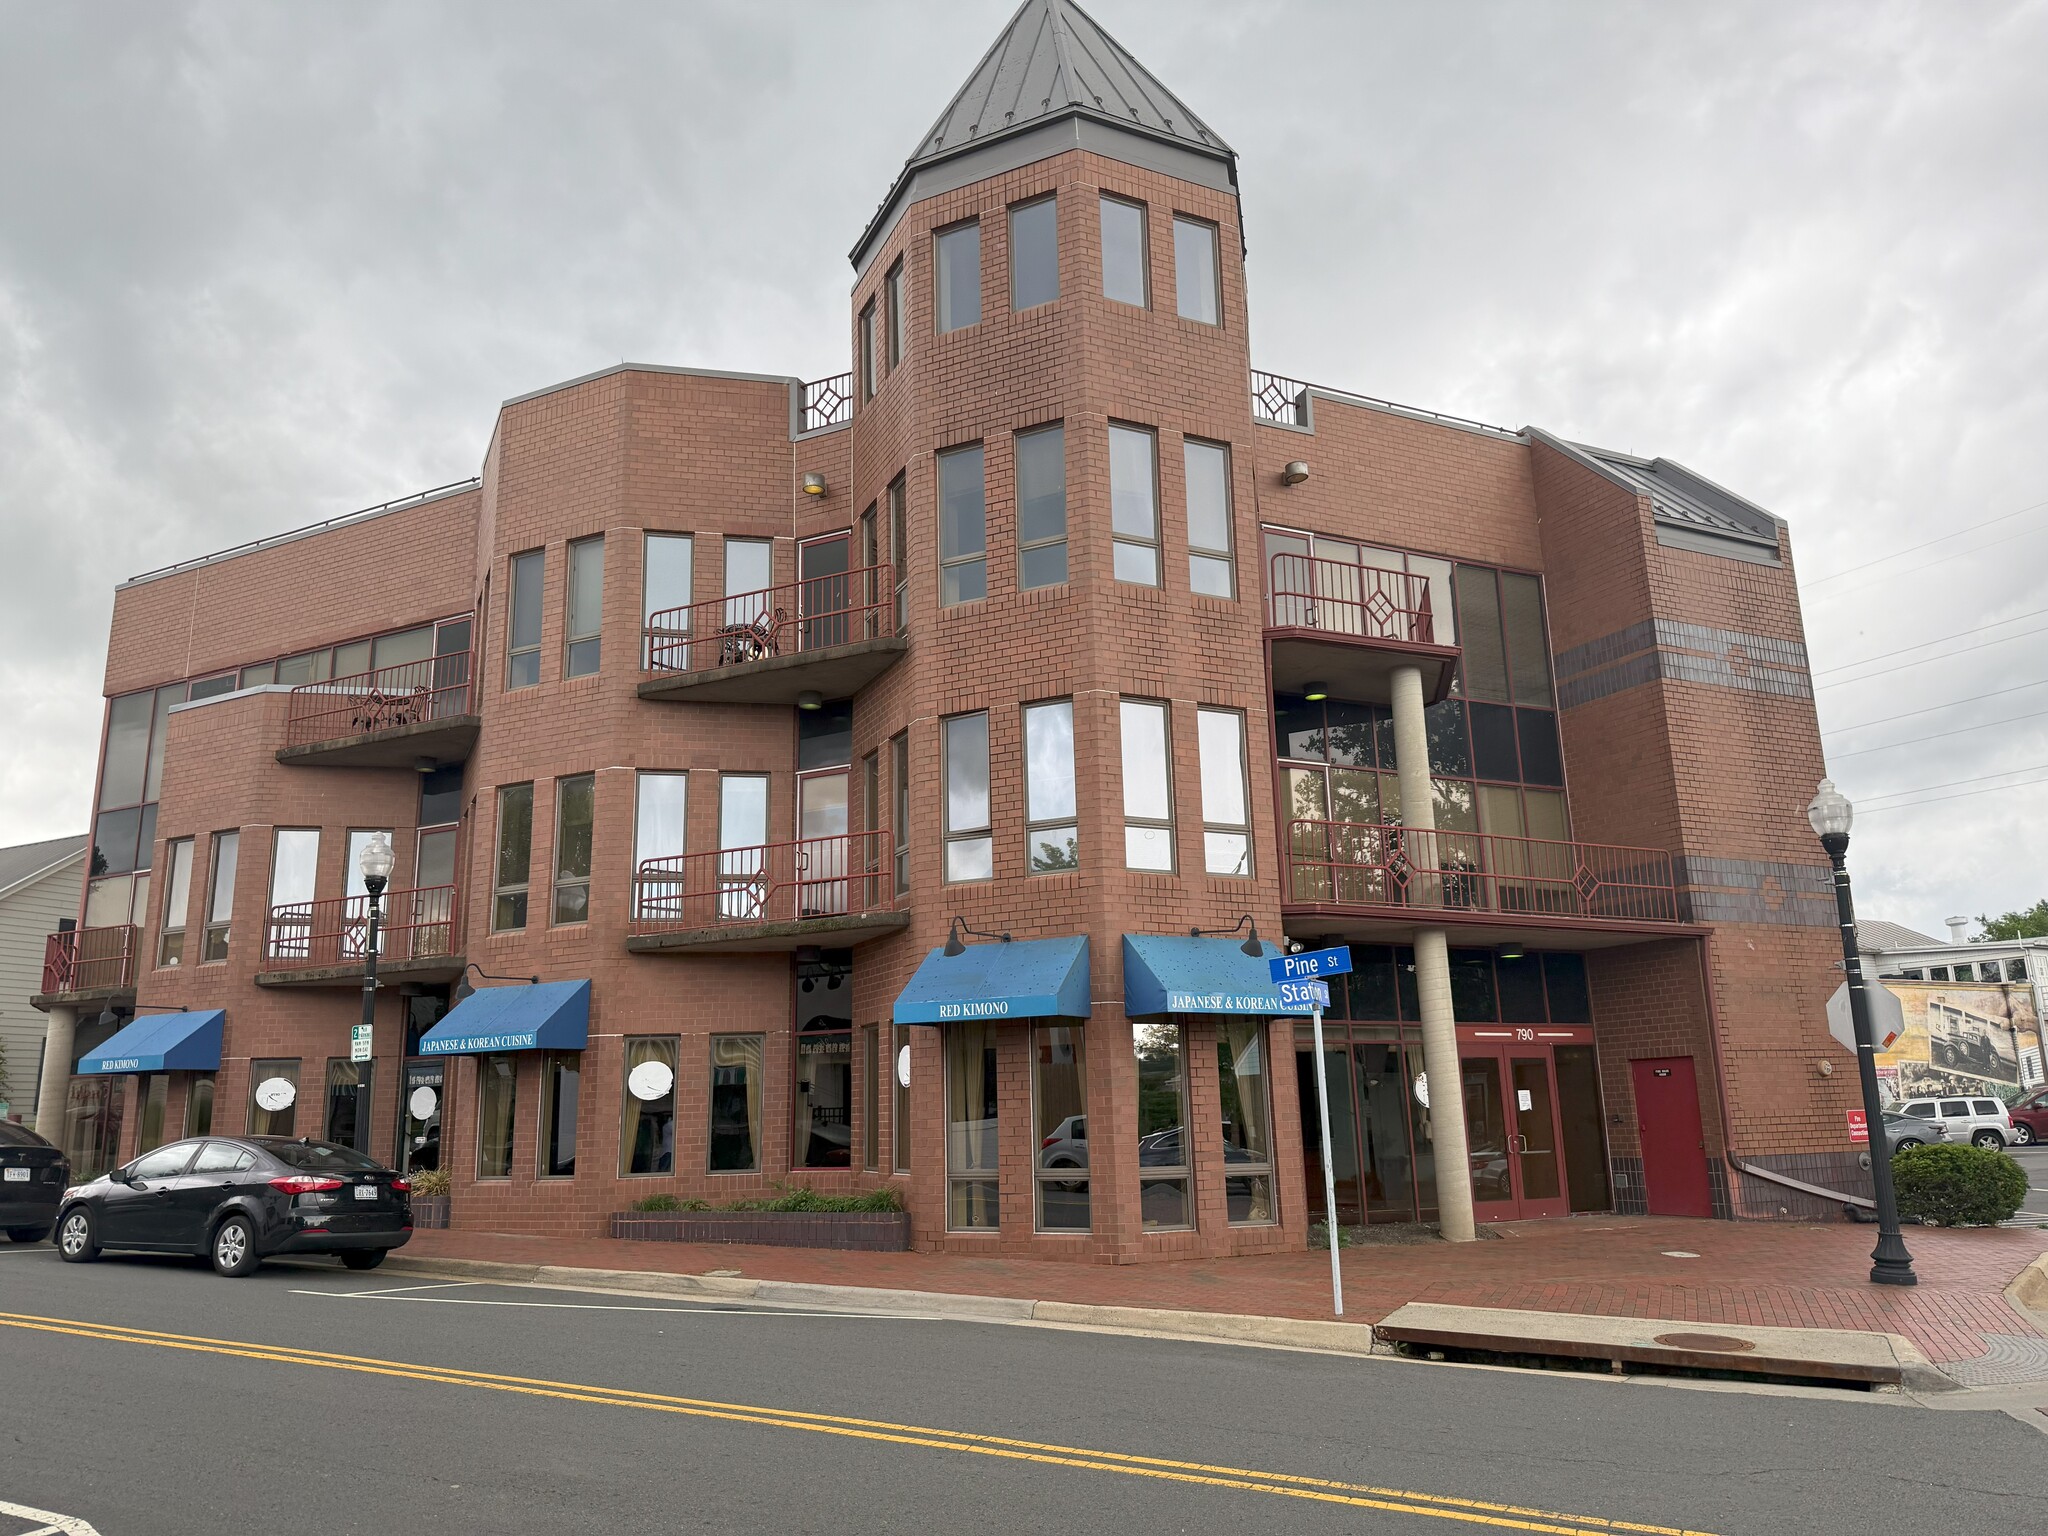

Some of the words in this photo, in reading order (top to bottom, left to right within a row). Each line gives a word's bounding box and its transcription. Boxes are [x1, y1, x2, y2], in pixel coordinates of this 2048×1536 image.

[1284, 957, 1319, 977] Pine
[1327, 956, 1338, 967] St
[940, 1004, 961, 1018] RED
[963, 1001, 1008, 1016] KIMONO
[1172, 995, 1223, 1009] JAPANESE
[1225, 997, 1233, 1010] &
[1235, 996, 1278, 1010] KOREAN
[353, 1029, 358, 1038] 2
[1515, 1028, 1534, 1041] 790
[421, 1039, 459, 1052] JAPANESE
[460, 1039, 467, 1050] &
[467, 1036, 501, 1049] KOREAN
[501, 1034, 533, 1047] CUISINE
[102, 1060, 113, 1070] RED
[114, 1059, 139, 1069] KIMONO
